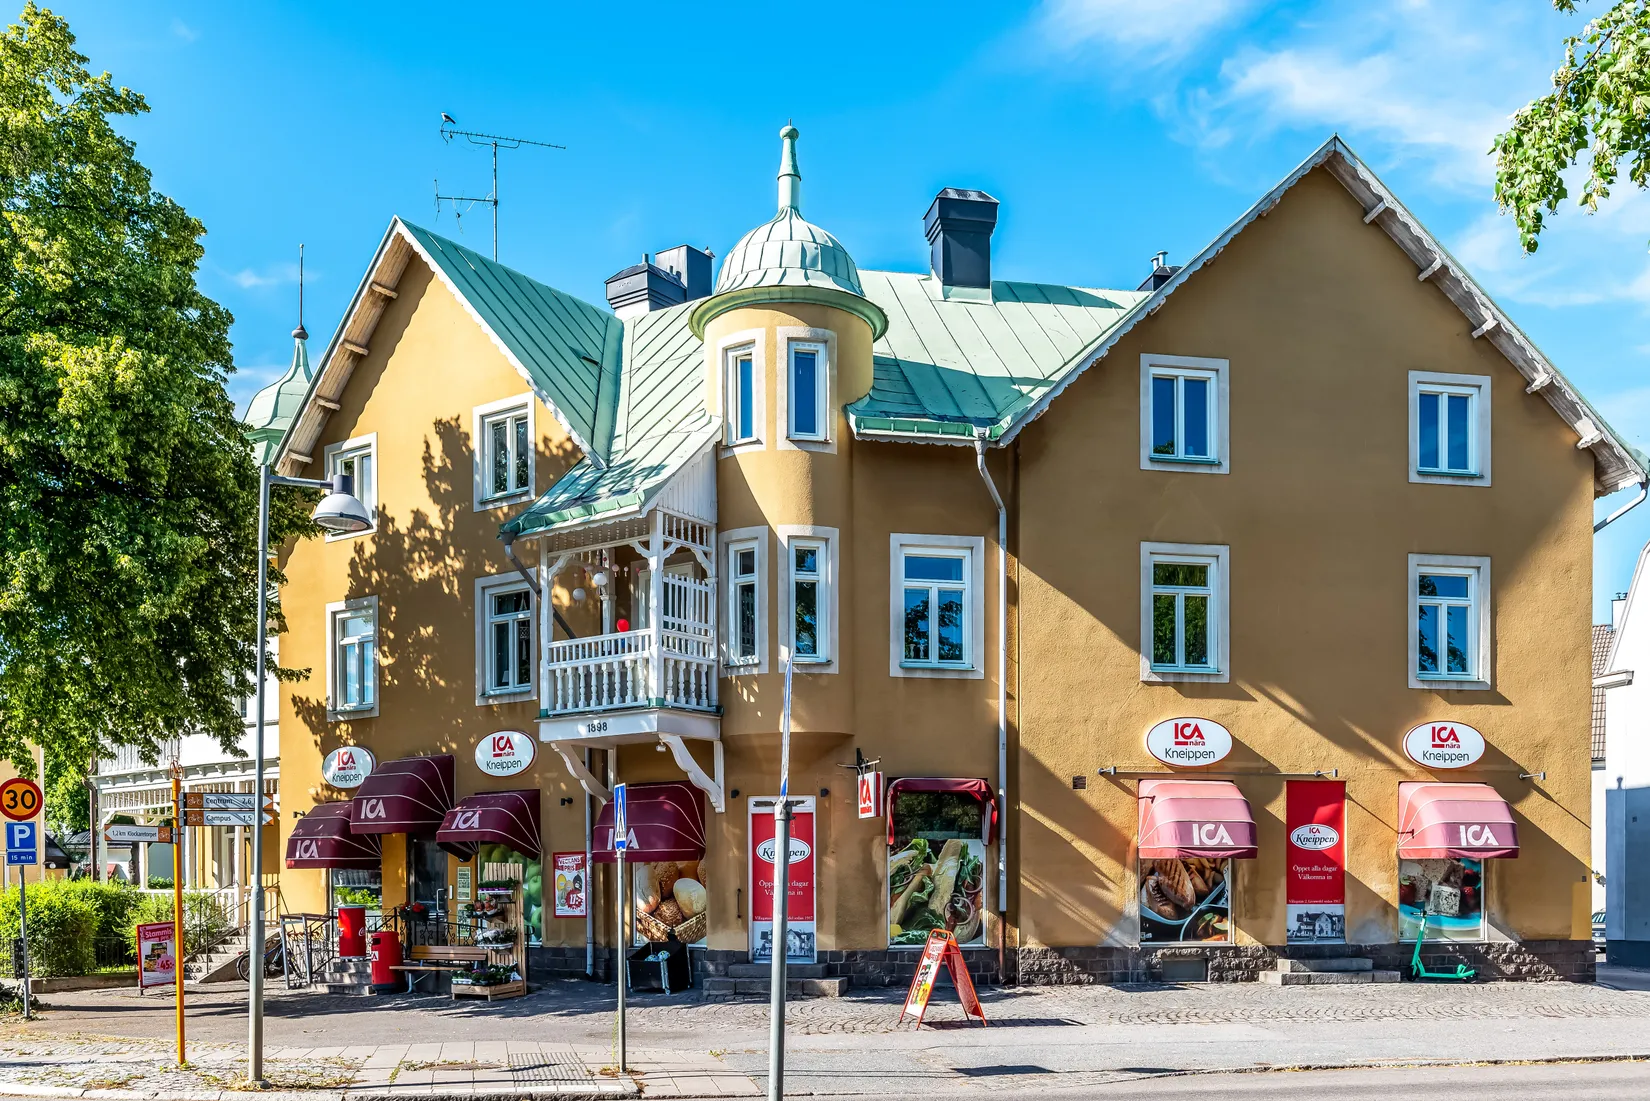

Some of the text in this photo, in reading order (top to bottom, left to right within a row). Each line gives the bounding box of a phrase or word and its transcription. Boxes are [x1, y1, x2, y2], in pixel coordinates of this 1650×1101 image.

[587, 722, 608, 733] 1898
[1174, 723, 1205, 740] ICA
[1432, 726, 1460, 743] ICA
[492, 736, 514, 752] ICA
[337, 751, 356, 766] ICA
[1165, 748, 1216, 761] Kneippen
[1422, 751, 1470, 763] Kneippen
[486, 760, 522, 771] Kneippen
[332, 773, 363, 783] Kneippen
[5, 789, 36, 809] 30
[860, 778, 872, 805] ICA
[361, 799, 386, 819] ICA
[451, 811, 480, 829] ICA
[13, 825, 31, 848] P
[607, 828, 640, 850] IA
[1192, 823, 1235, 846] ICA
[1296, 834, 1335, 845] Kneippen
[1460, 825, 1499, 846] ICA
[296, 840, 319, 858] ICA
[762, 847, 806, 859] Knpen
[1322, 865, 1338, 873] dagar
[791, 880, 809, 888] dagar
[797, 888, 803, 896] in
[145, 928, 173, 938] Stammis
